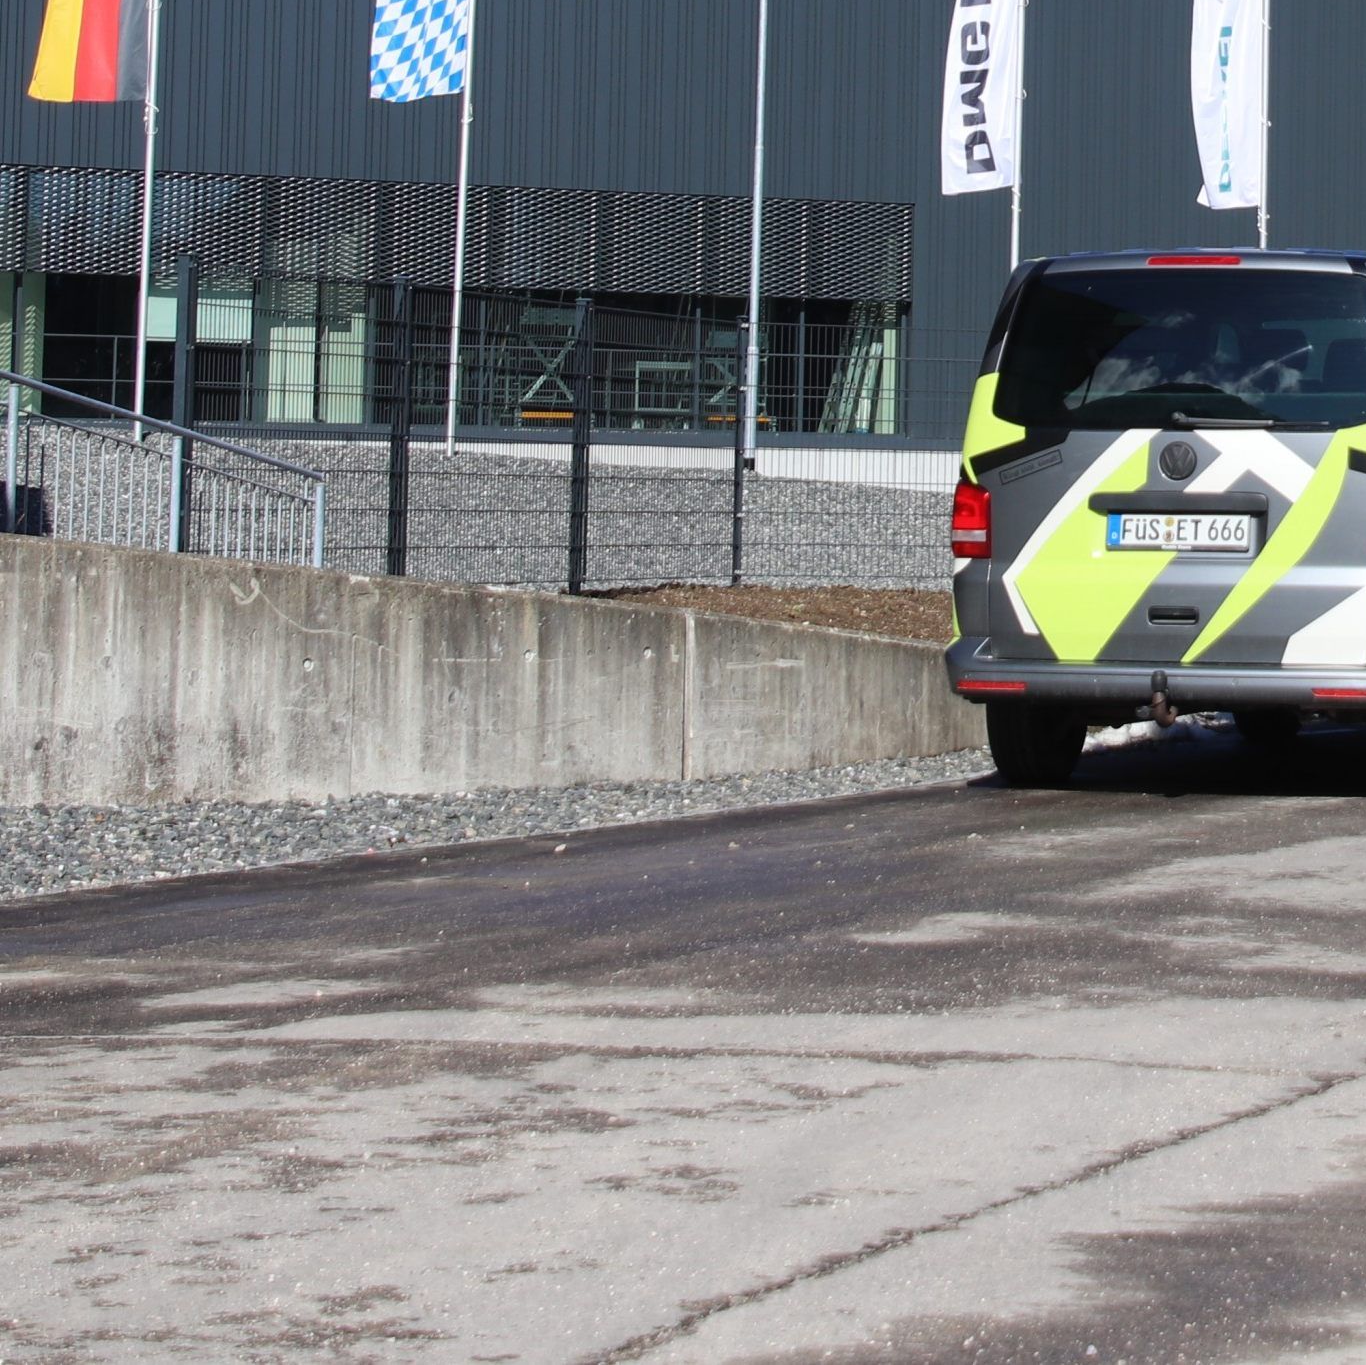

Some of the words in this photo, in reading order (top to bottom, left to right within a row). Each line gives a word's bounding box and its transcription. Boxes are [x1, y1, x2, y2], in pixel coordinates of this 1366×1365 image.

[960, 21, 996, 174] DMG
[1176, 518, 1202, 542] ET
[1207, 518, 1245, 542] 666
